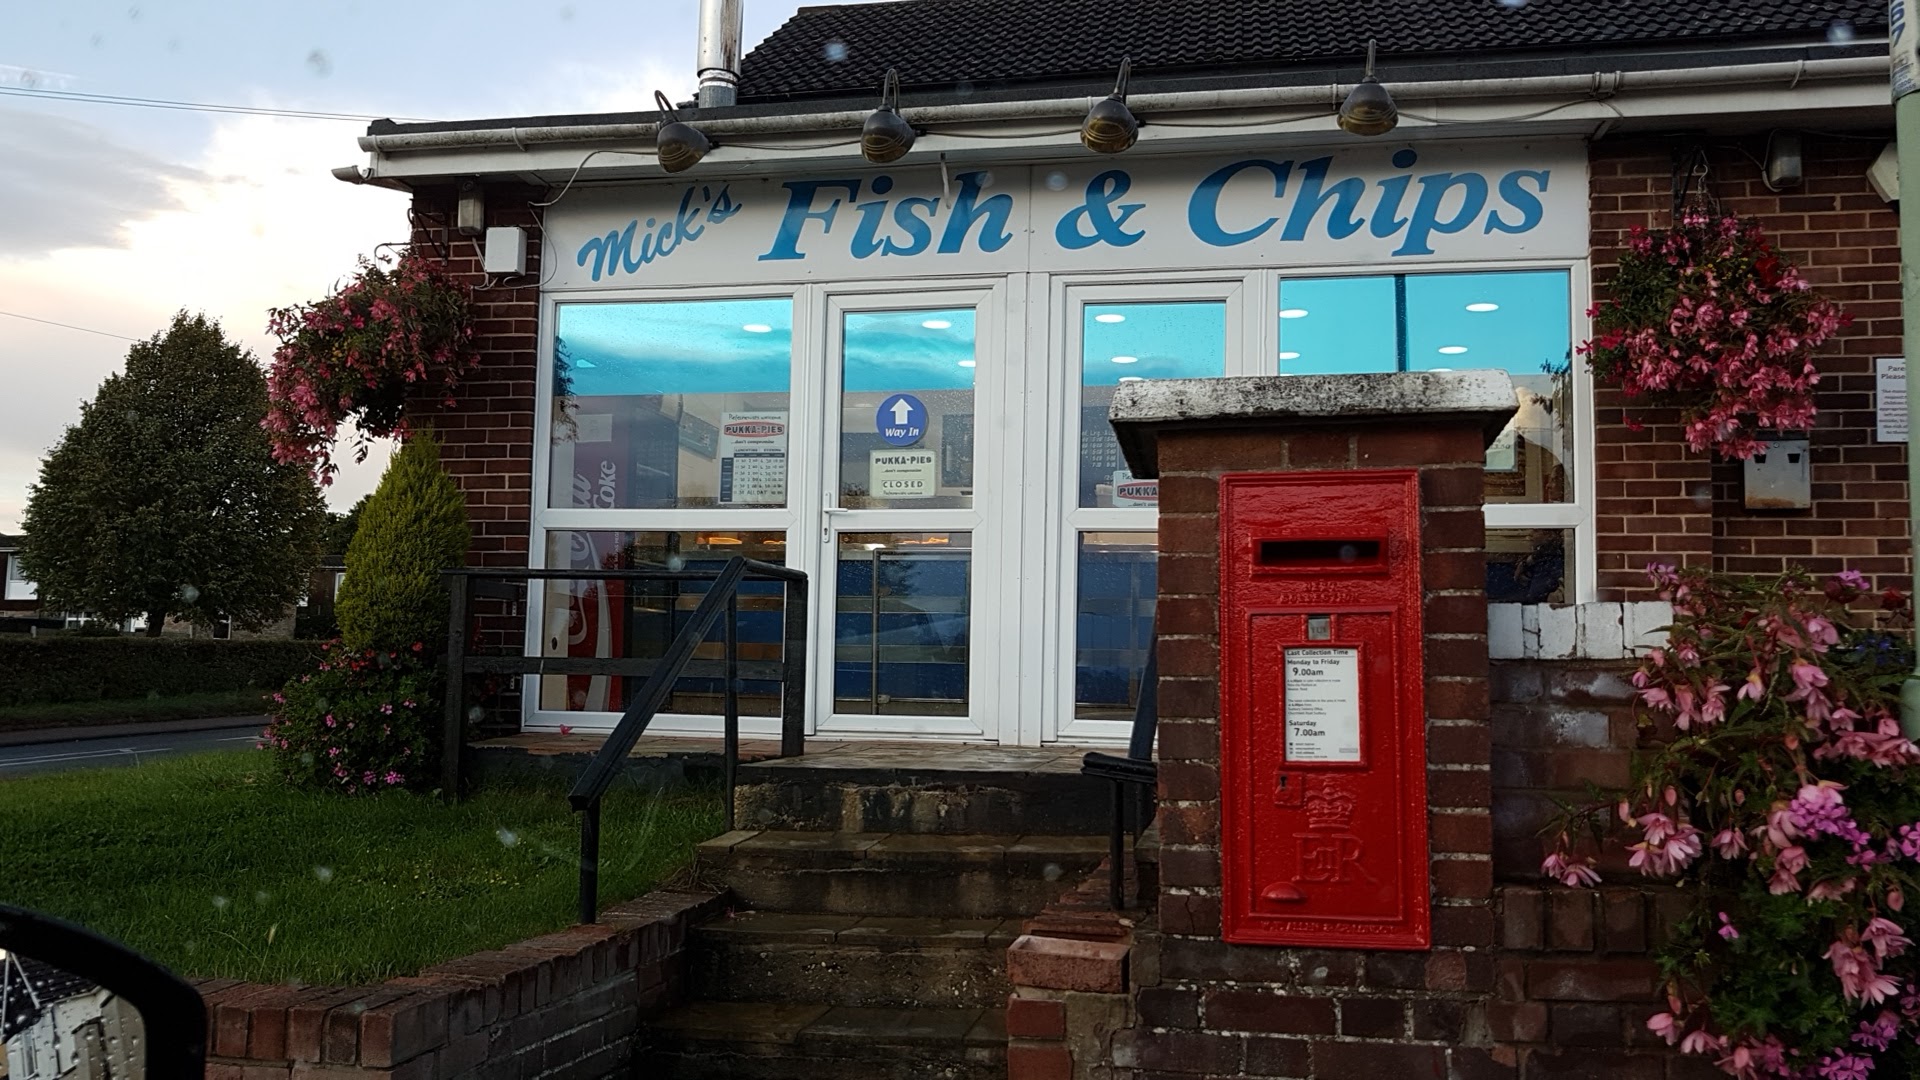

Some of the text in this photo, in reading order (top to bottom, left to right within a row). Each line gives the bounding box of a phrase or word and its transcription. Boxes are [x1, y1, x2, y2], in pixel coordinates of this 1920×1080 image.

[577, 149, 1551, 282] Mick's Fish & Chips
[885, 427, 919, 438] Way In
[593, 460, 617, 508] Coke
[1292, 667, 1324, 676] 9.00am
[1294, 727, 1326, 737] 7.00am
